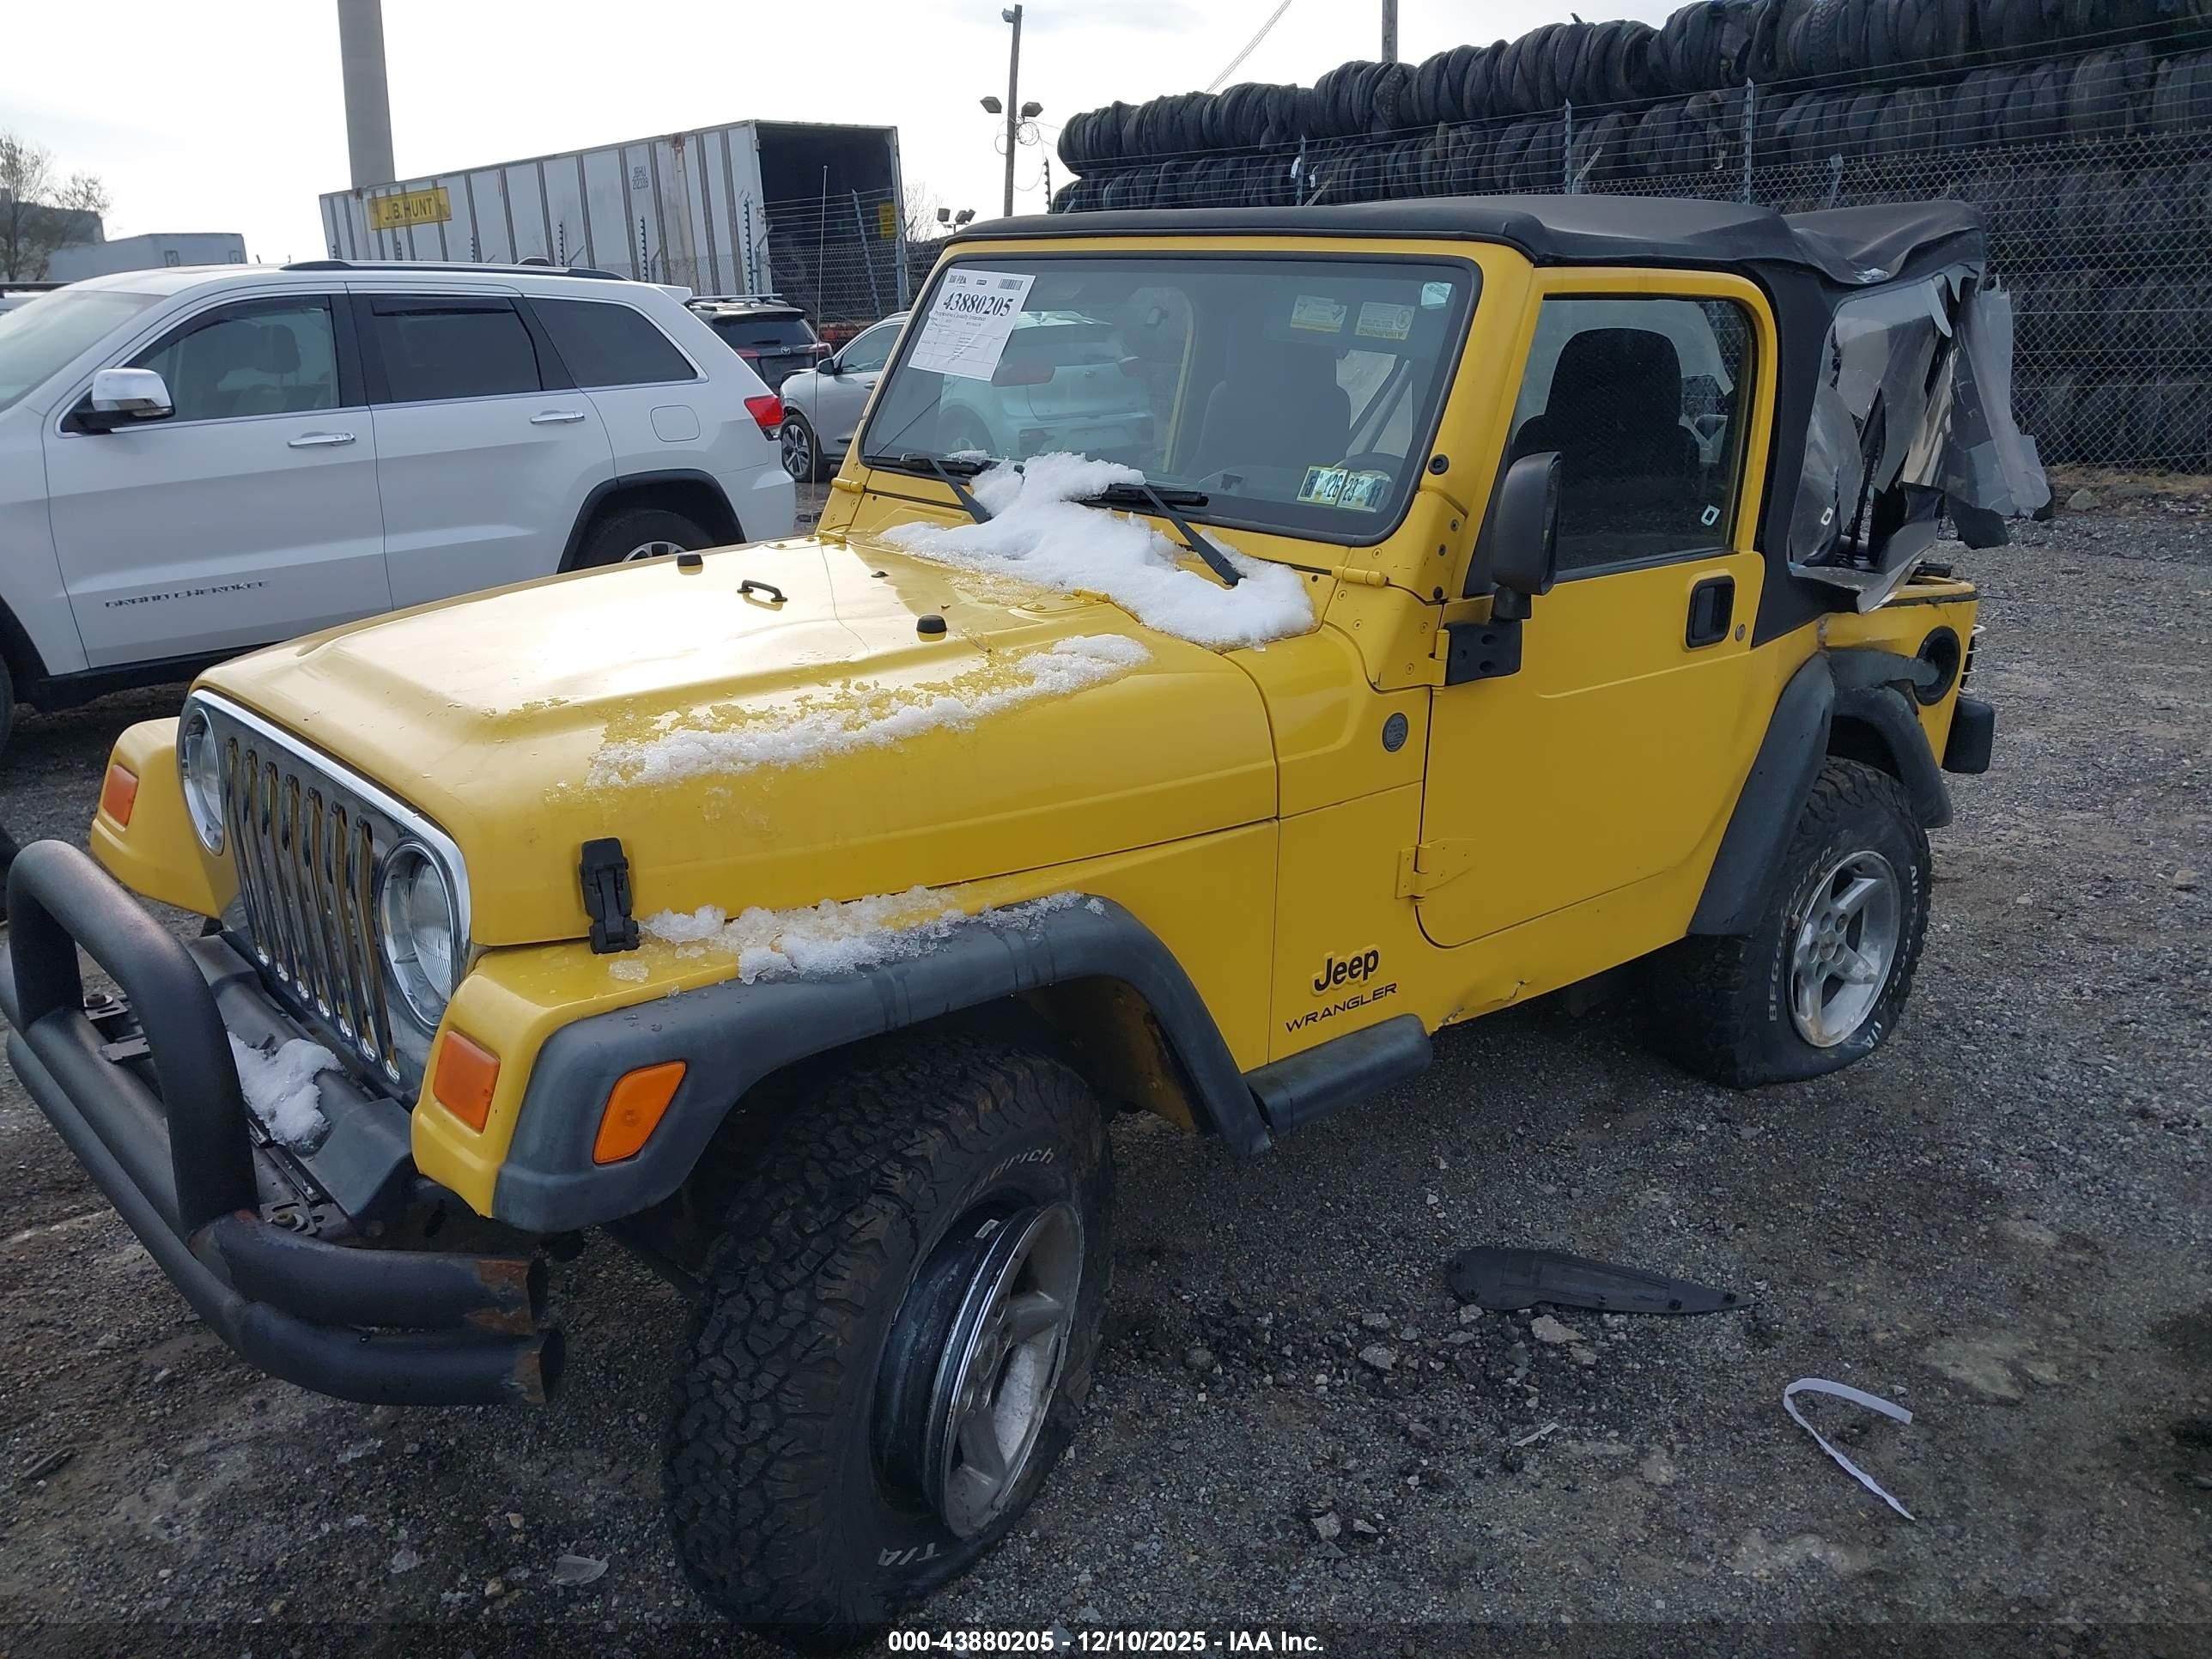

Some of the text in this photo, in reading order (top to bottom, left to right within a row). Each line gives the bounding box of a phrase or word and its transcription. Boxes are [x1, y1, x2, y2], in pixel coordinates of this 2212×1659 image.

[404, 197, 433, 219] HUNT
[943, 292, 1015, 317] 43880205
[1313, 949, 1379, 992] Jeep
[1285, 982, 1398, 1033] WRANGLER
